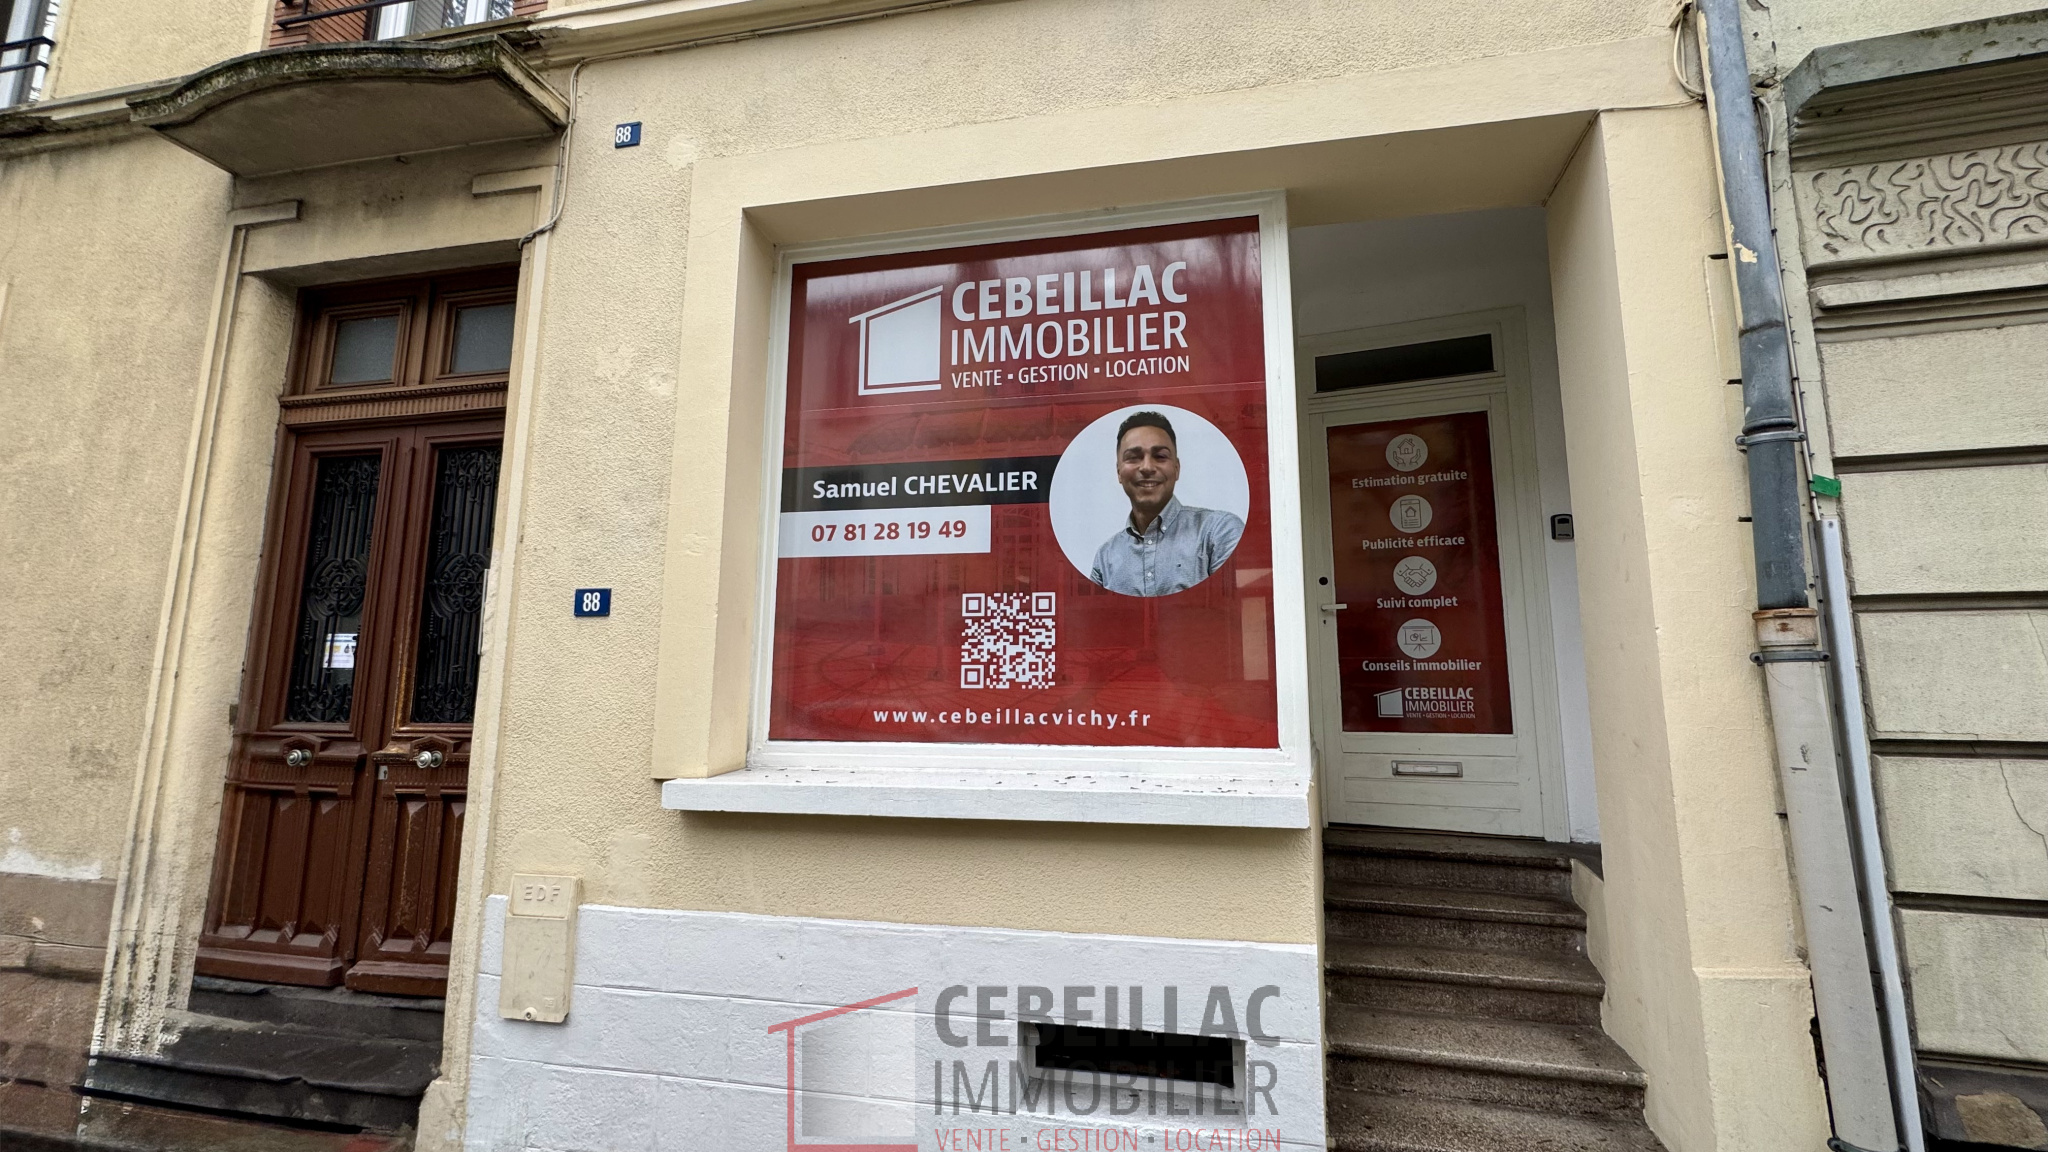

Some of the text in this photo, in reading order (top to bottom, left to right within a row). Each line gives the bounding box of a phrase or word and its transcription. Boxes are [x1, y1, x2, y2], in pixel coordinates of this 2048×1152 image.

[615, 125, 632, 144] 88
[951, 260, 1189, 322] CEBEILLAC
[951, 310, 1189, 366] IMMOBILIER
[951, 355, 1190, 390] VENTE GESTION LOCATION
[812, 470, 1038, 499] Samuel CHEVALIER
[1351, 469, 1468, 489] Estimation gratuite
[811, 519, 967, 542] 07 81 28 19 49
[1362, 535, 1466, 550] Publicité efficace
[582, 591, 601, 612] 88
[1376, 595, 1459, 610] Suivi complet
[1361, 659, 1482, 672] Conseils immobilier
[1404, 687, 1474, 700] CEBEILLAC
[1405, 700, 1475, 712] IMMOBILIER
[873, 708, 1151, 729] www.cebeillacvichy.fr
[523, 884, 561, 902] EDF
